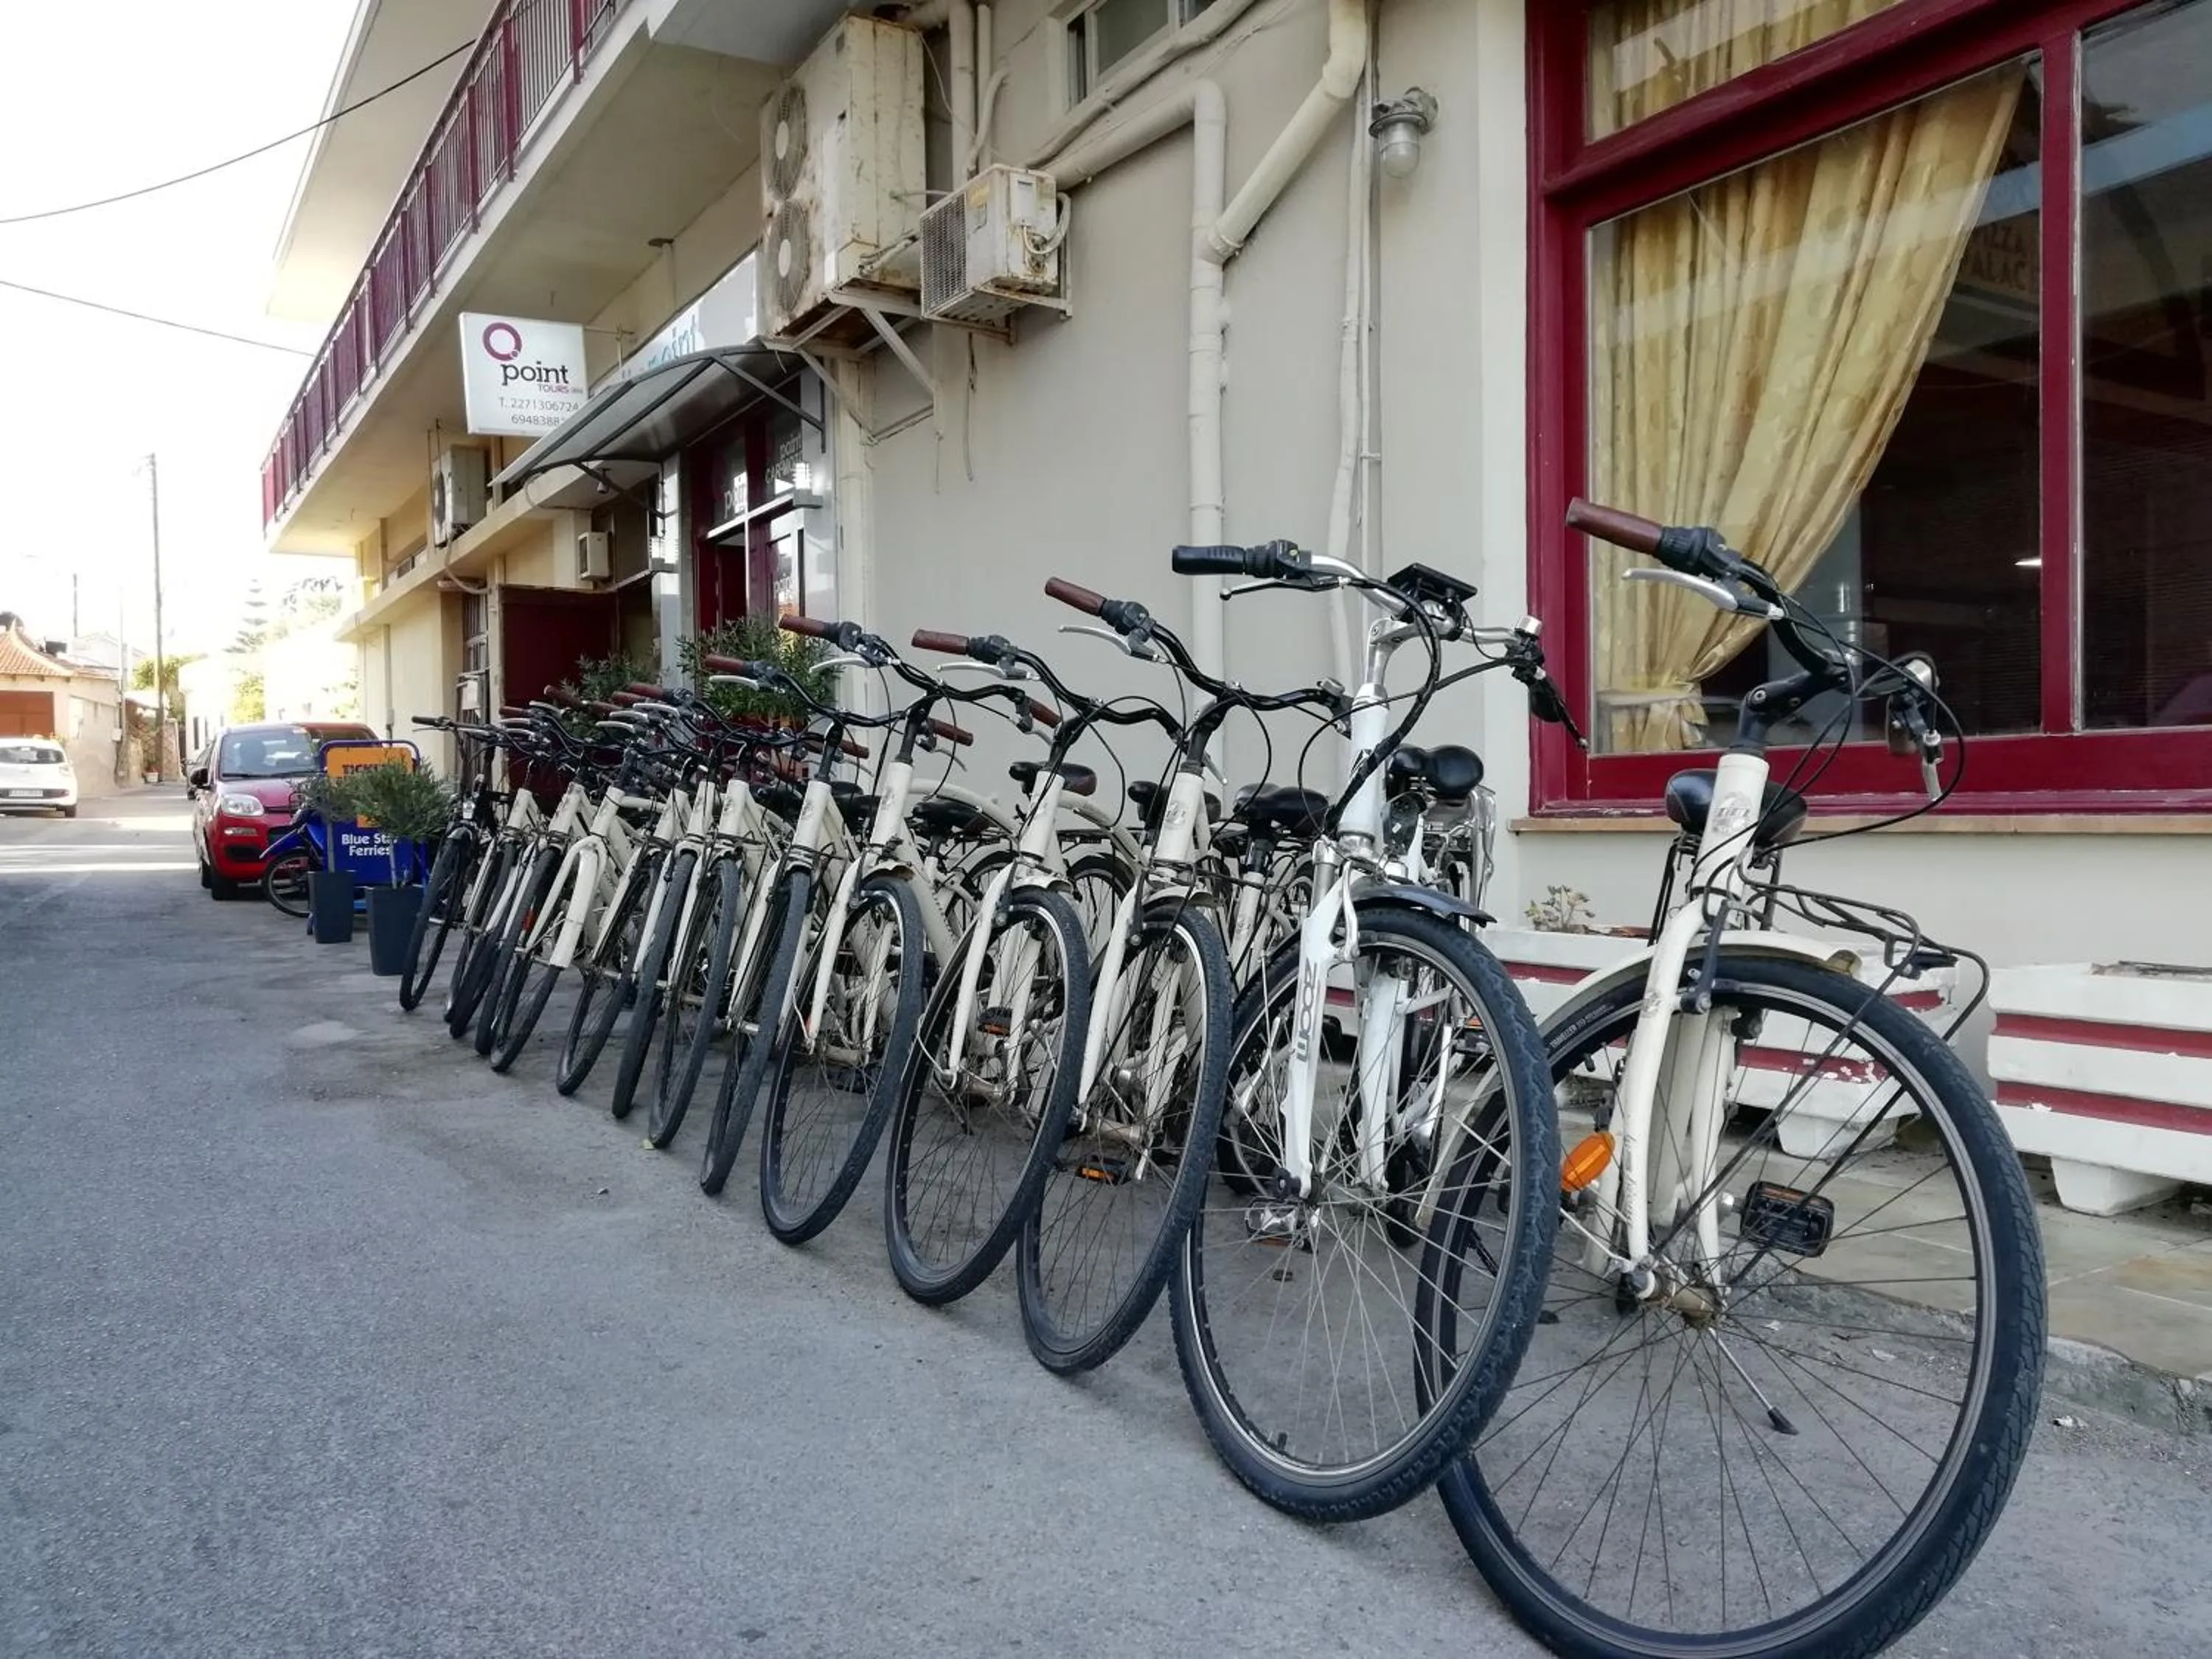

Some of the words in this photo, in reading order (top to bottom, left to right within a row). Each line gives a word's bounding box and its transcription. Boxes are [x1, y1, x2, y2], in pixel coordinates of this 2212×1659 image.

[501, 361, 569, 386] point
[538, 383, 569, 394] TOURS
[341, 834, 369, 844] Blue
